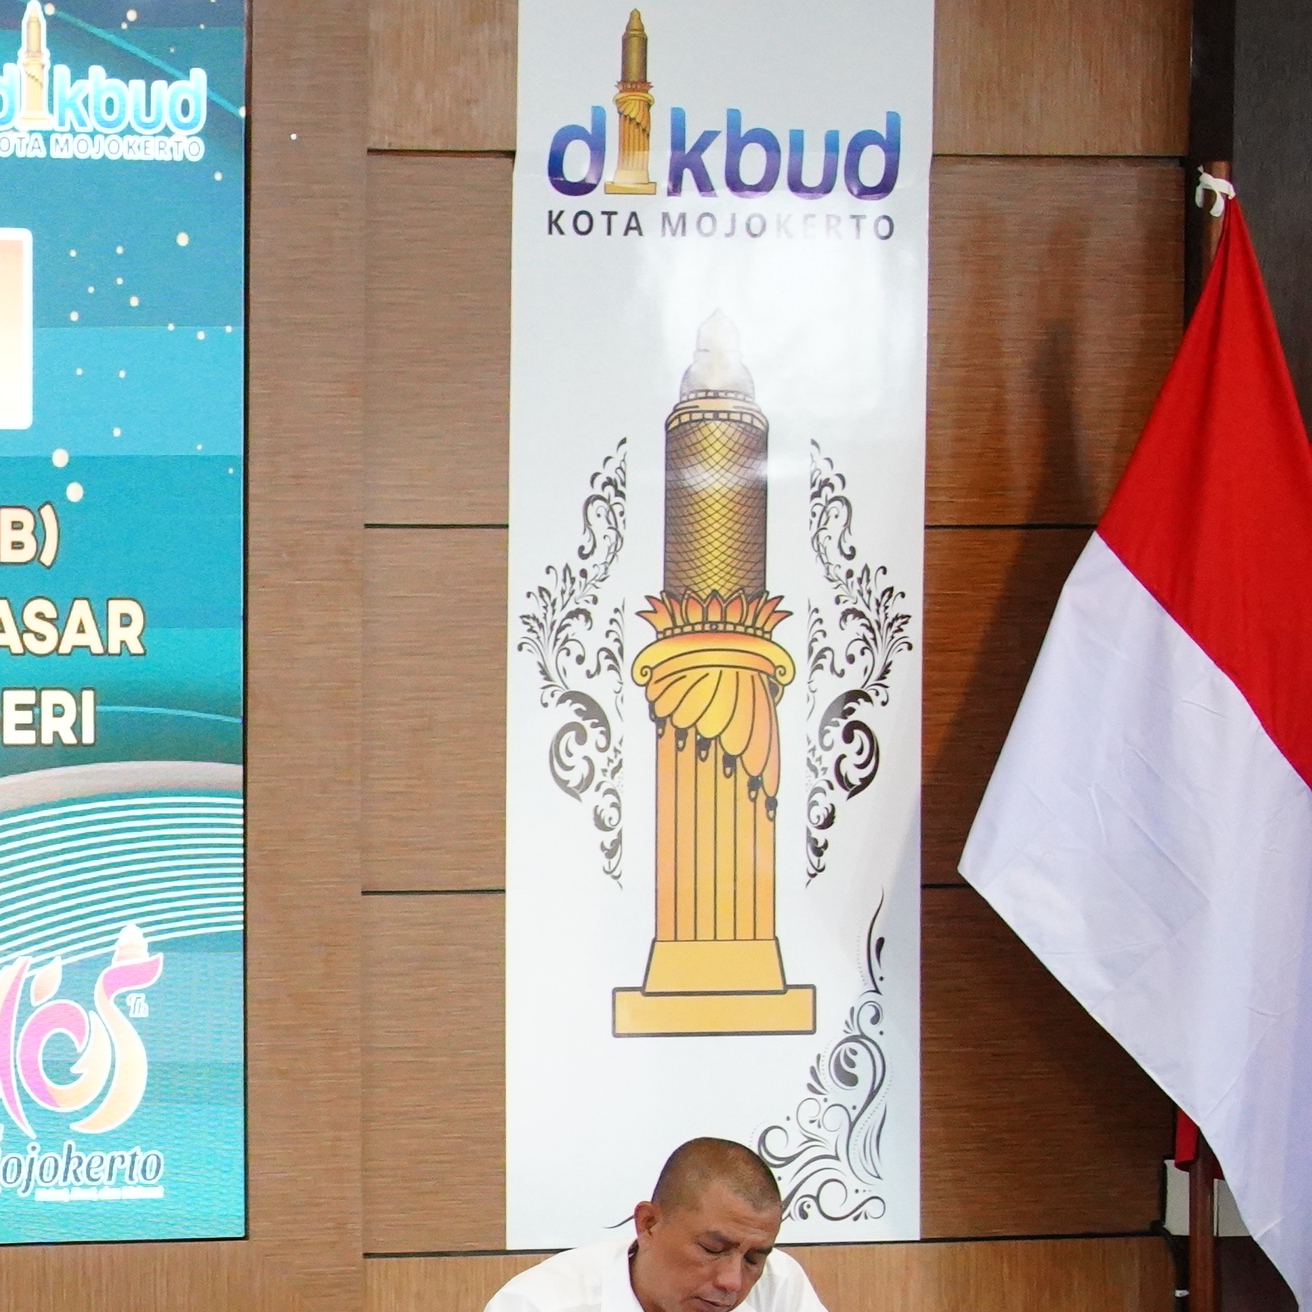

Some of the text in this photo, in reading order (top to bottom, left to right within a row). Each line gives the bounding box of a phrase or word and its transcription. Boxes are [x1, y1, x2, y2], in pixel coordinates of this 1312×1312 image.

[51, 133, 205, 161] MOJOKERTO
[547, 208, 896, 241] KOTA MOJOKERTO
